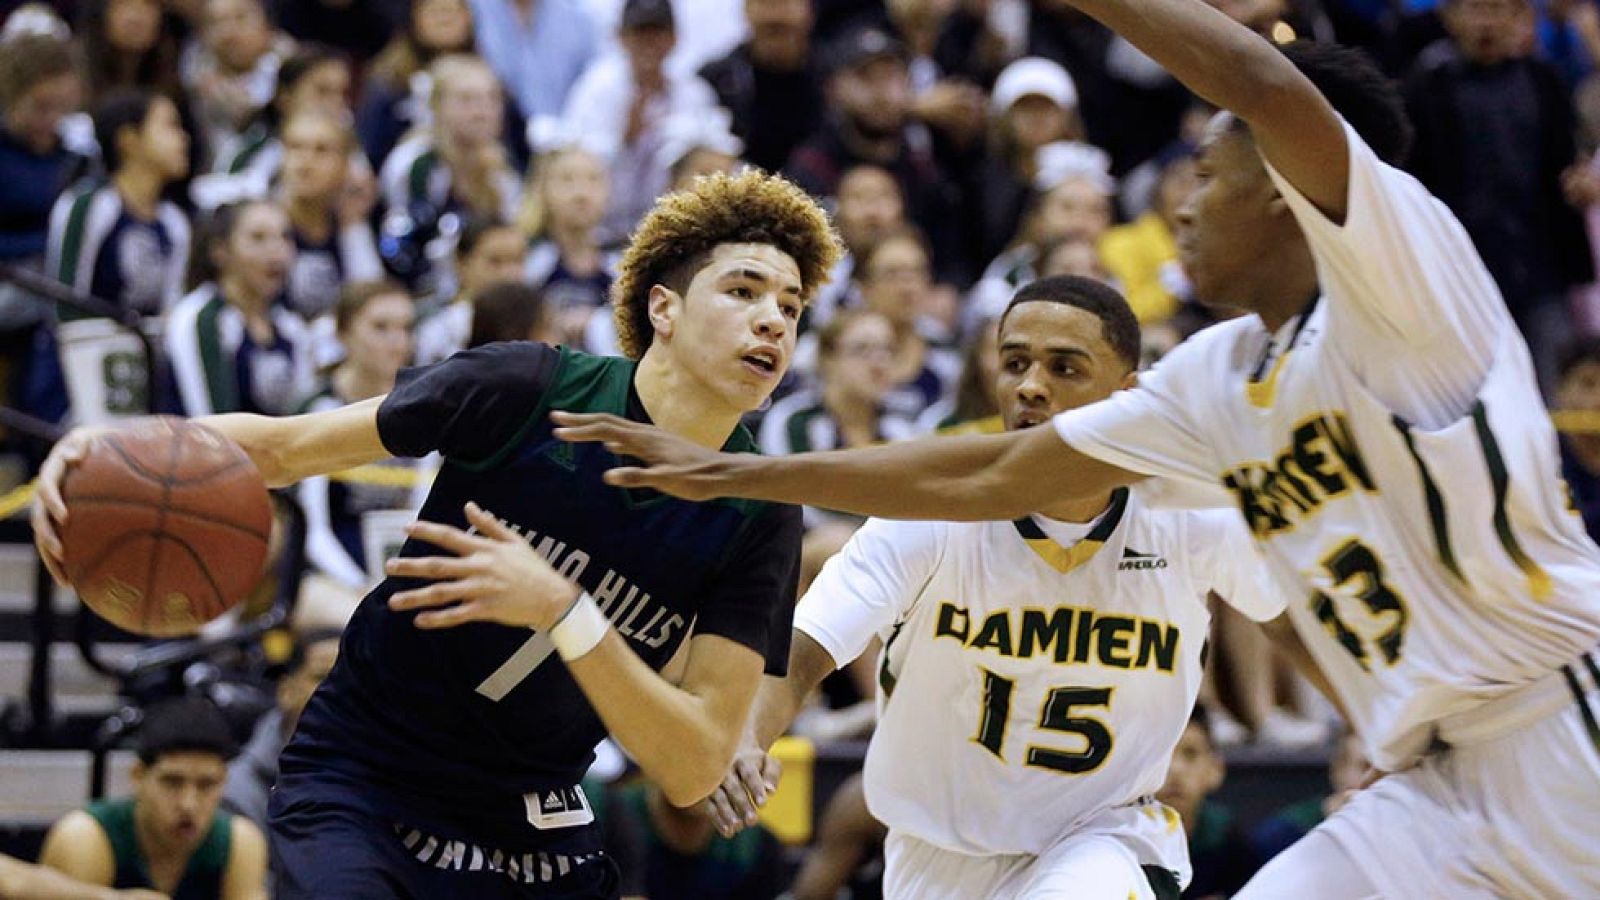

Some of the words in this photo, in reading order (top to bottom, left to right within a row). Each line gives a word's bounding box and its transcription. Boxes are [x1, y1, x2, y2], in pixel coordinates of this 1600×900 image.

[592, 569, 684, 649] HILLS
[933, 600, 1181, 677] DAMIEN
[968, 665, 1117, 776] 15
